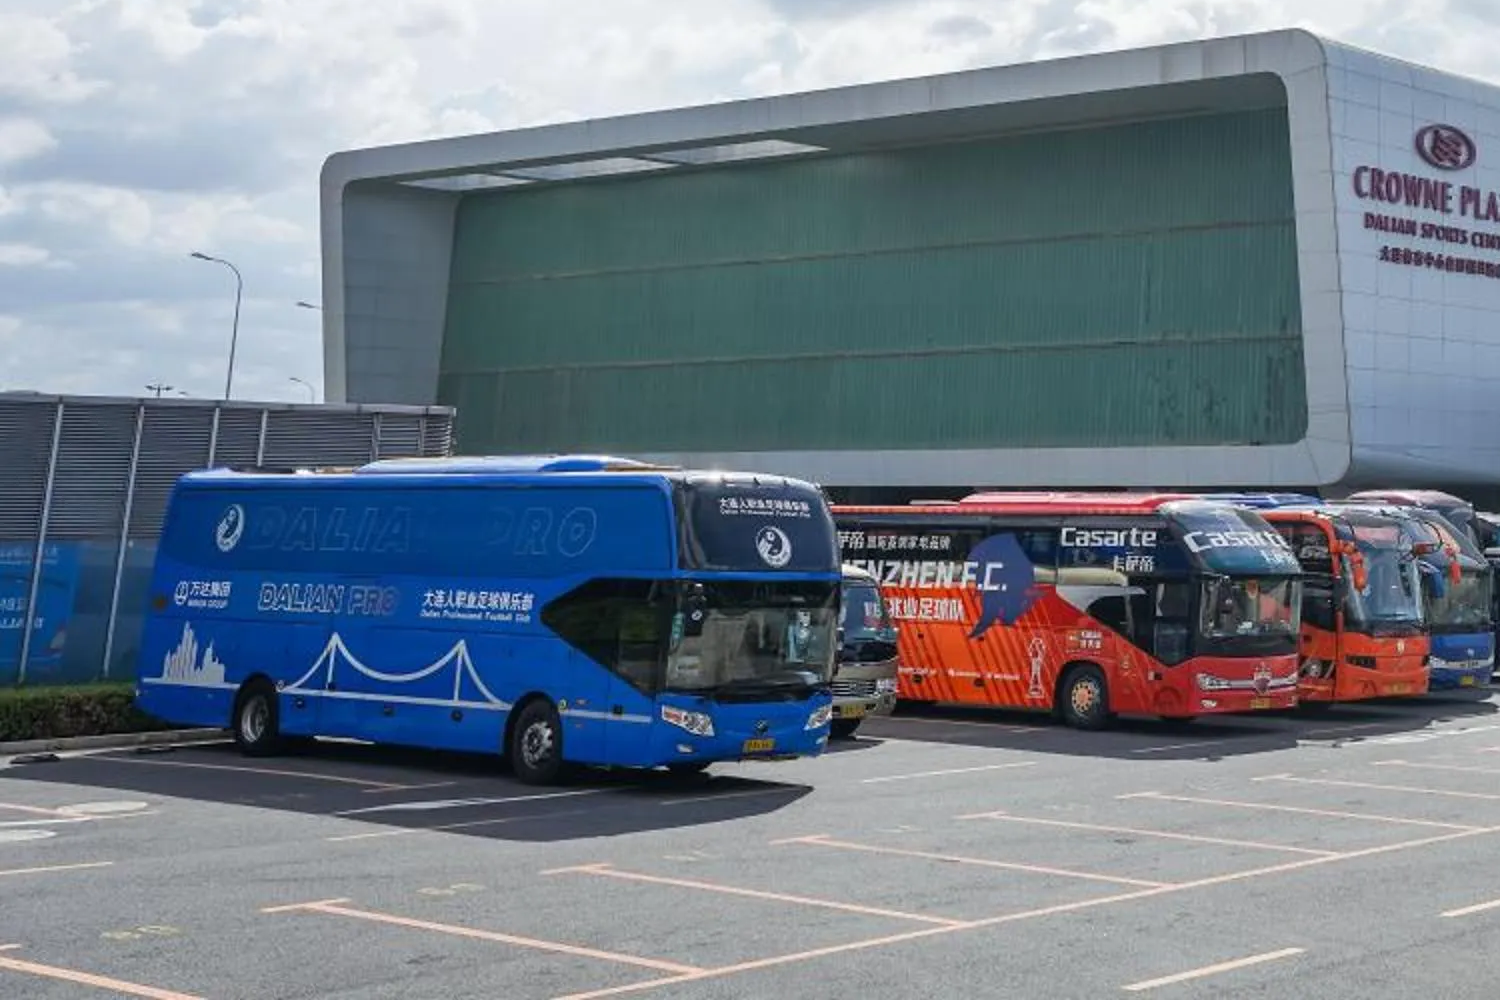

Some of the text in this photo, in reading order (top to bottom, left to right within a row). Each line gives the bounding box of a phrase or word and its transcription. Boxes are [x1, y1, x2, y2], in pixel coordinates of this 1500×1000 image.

[1353, 165, 1453, 214] CROWNE
[1363, 212, 1417, 236] DALIAN
[1420, 222, 1468, 245] SPORTS
[1061, 527, 1157, 547] Casarte
[957, 562, 1007, 592] F.C.
[257, 583, 399, 616] DALIAN PRO
[422, 589, 534, 611] 大连人职业足球俱乐部
